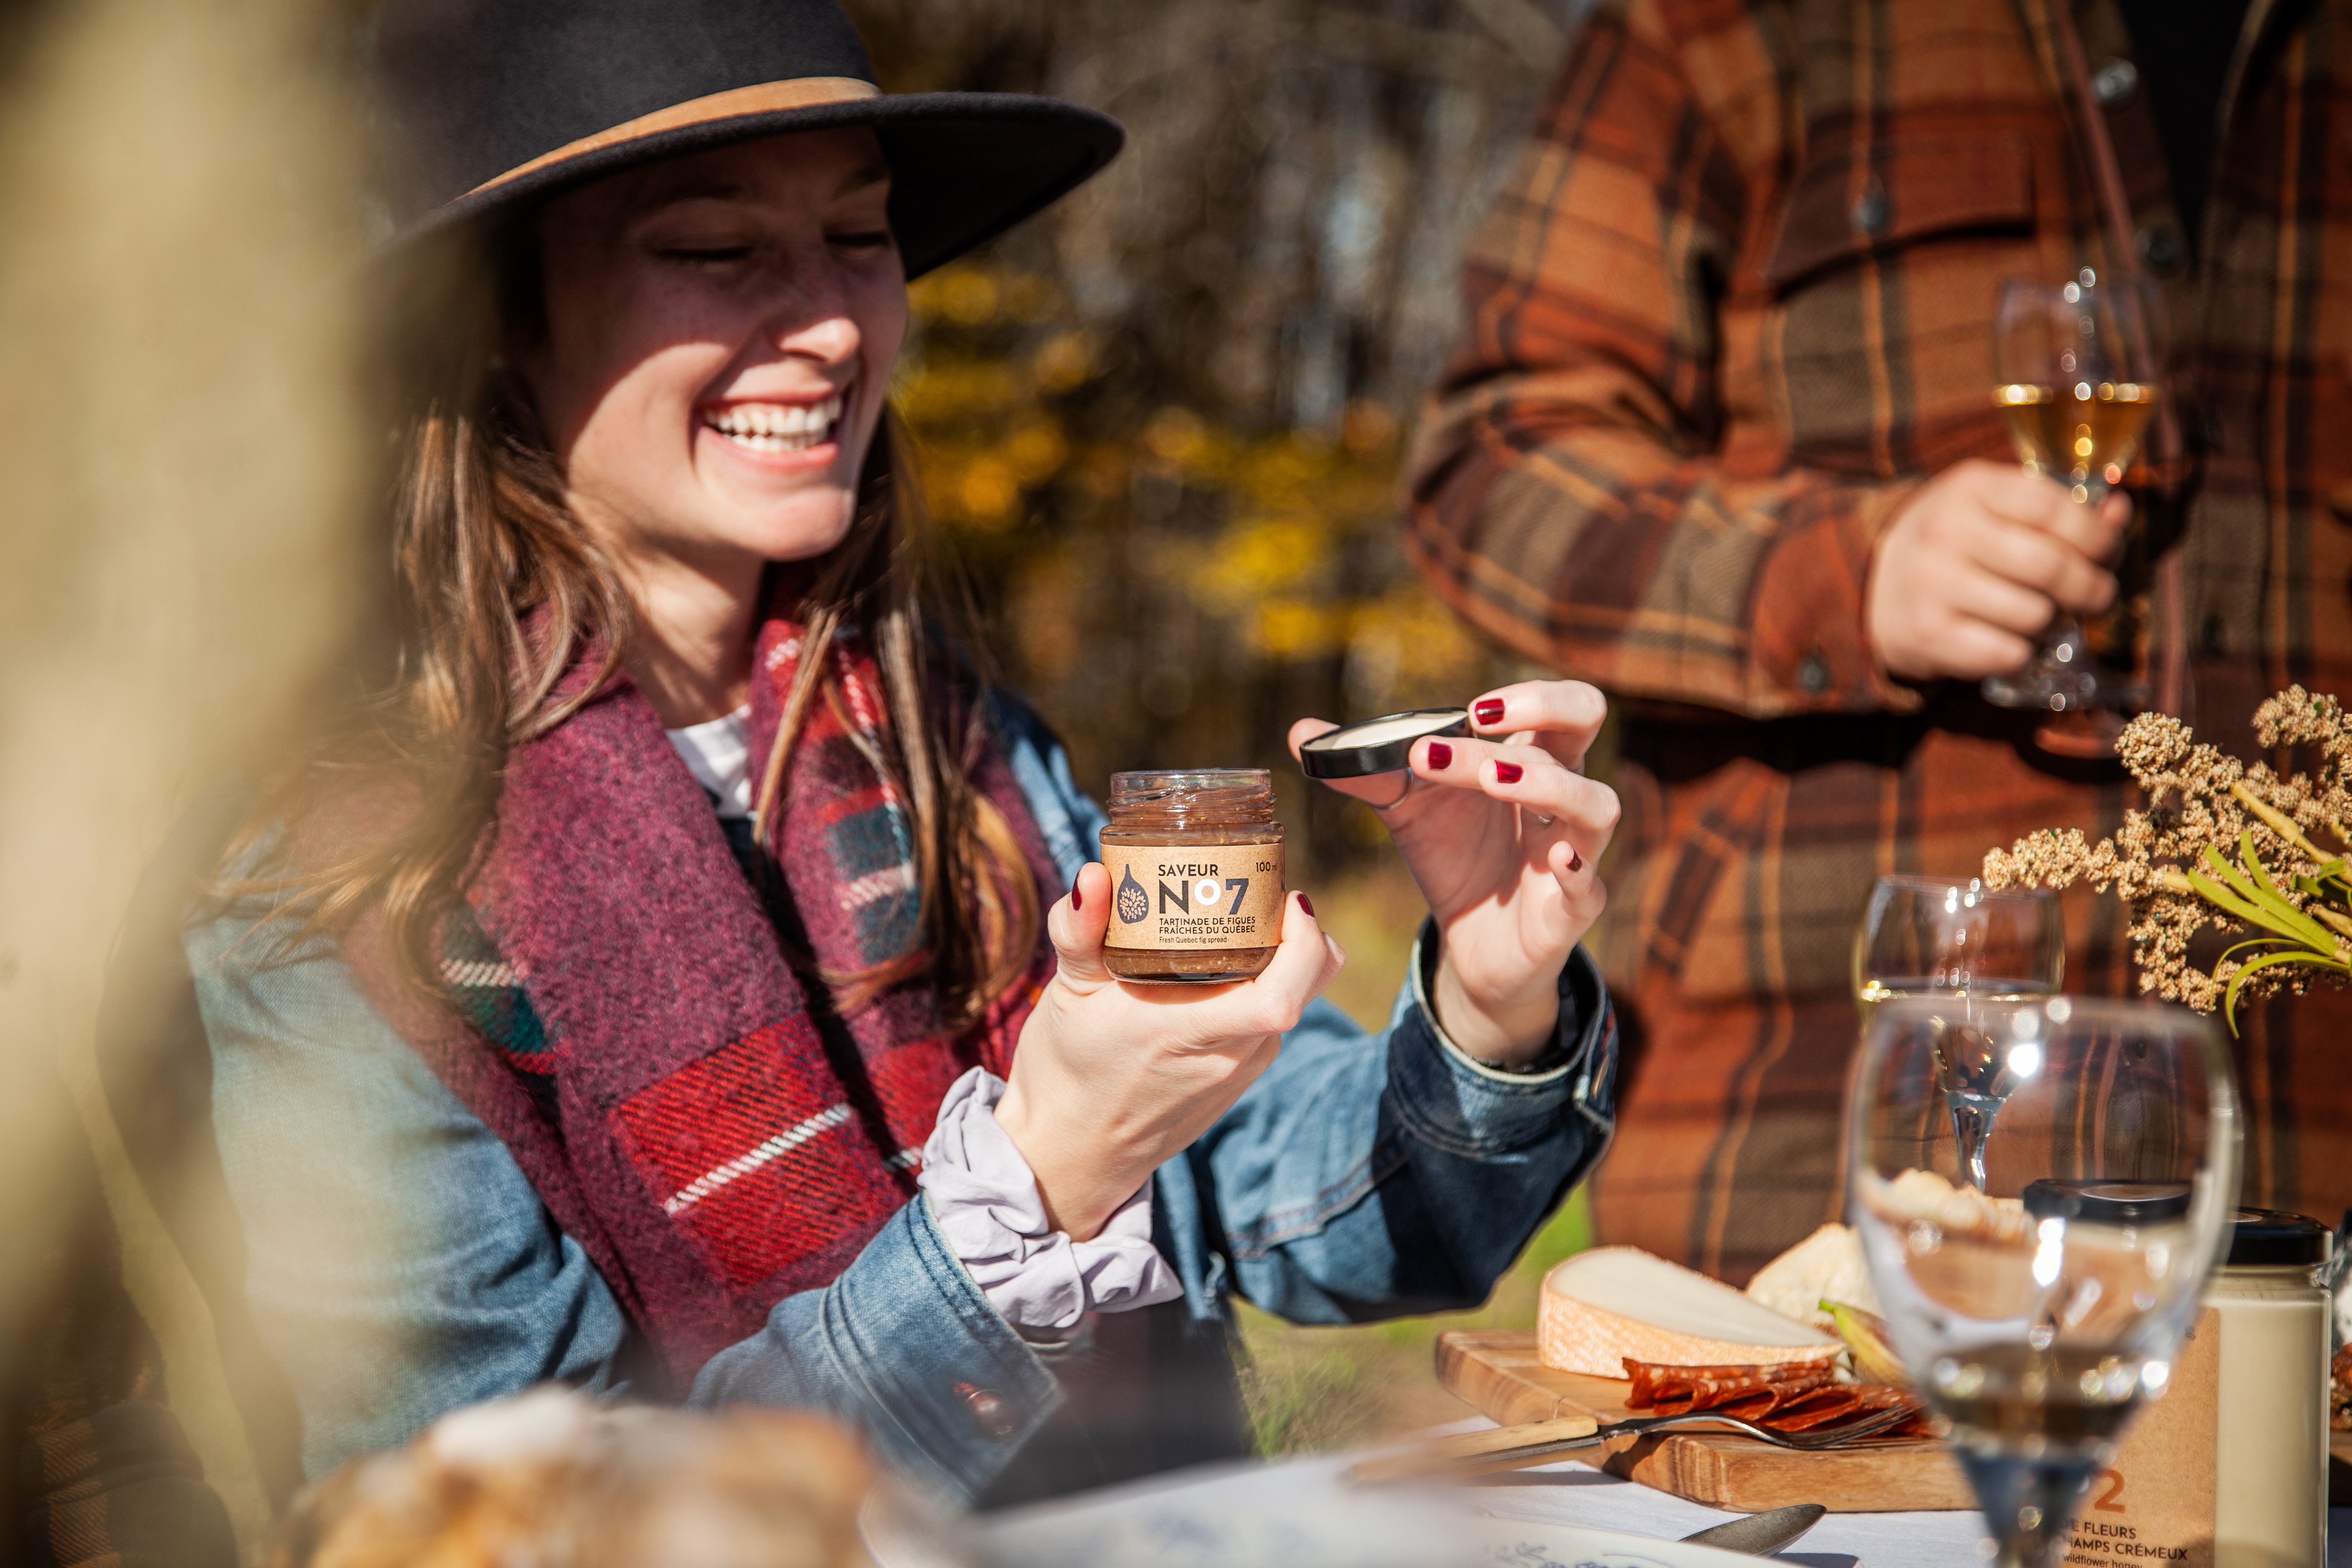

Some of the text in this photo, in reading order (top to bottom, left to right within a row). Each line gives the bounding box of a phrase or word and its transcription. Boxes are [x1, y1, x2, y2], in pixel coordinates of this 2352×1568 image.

[1158, 864, 1219, 876] SAVEUR
[1256, 861, 1271, 872] 100
[1228, 916, 1256, 924] FIGUES
[1159, 926, 1203, 934] FRAÎCHES
[1222, 924, 1256, 933] QUÉBEC
[2084, 1522, 2137, 1539] FLEURS
[2115, 1542, 2189, 1561] CRÉMEUX
[2063, 1553, 2109, 1568] wildflower
